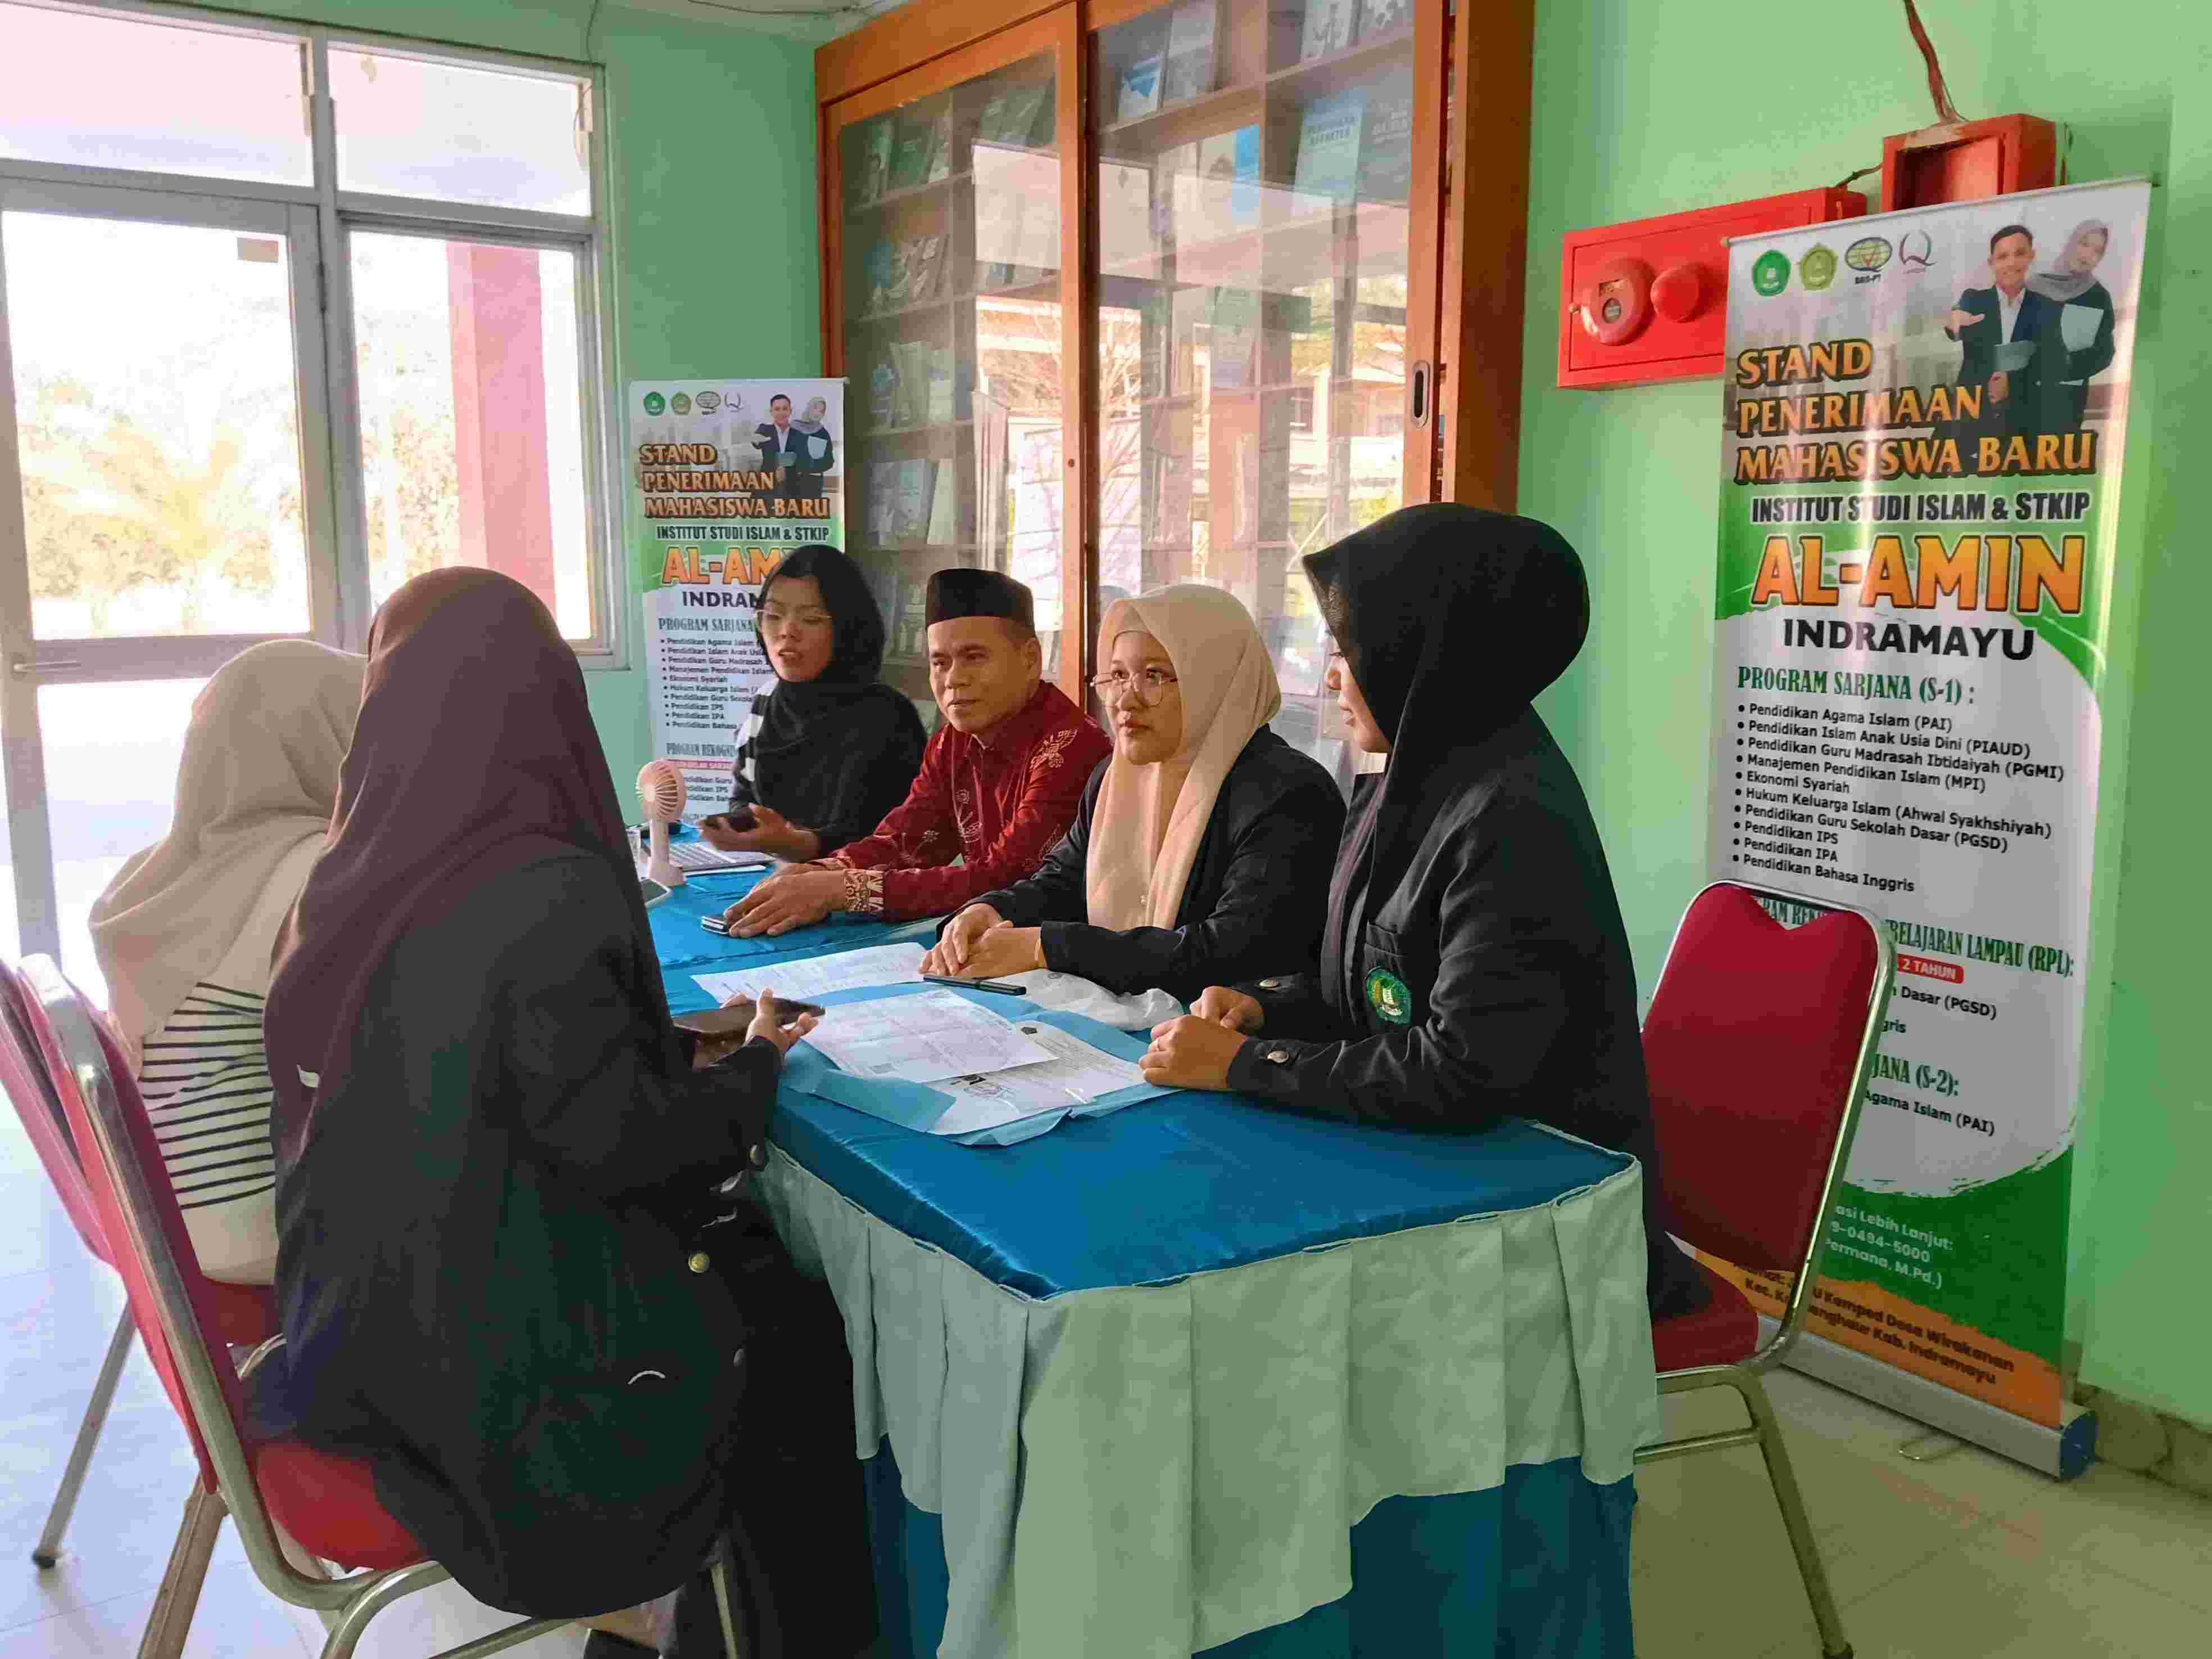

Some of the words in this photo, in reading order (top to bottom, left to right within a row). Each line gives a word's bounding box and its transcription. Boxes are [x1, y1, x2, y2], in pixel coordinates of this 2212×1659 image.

[1737, 339, 1872, 388] STAND
[1736, 386, 1983, 436] PENERIMAAN
[639, 444, 717, 465] STAND
[1735, 438, 1965, 484] MAHASISWA
[1977, 430, 2097, 475] BARU
[643, 472, 774, 492] PENERIMAAN
[645, 497, 768, 519] MAHASISWA
[774, 498, 831, 519] BARU
[1752, 496, 1843, 523] INSTITUT
[1916, 493, 1986, 520] ISLAM
[1992, 497, 2010, 519] &
[2015, 492, 2091, 520] STKIP
[656, 526, 706, 540] INSTITUT
[711, 526, 743, 540] STUDI
[746, 527, 780, 540] ISLAM
[783, 528, 793, 540] &
[795, 527, 829, 541] STKIP
[1750, 534, 2086, 614] AL-AMIN
[658, 618, 709, 631] PROGRAM
[1783, 618, 2034, 661] INDRAMAYU
[1737, 665, 1827, 693] PROGRAM
[1834, 672, 1911, 700] SARJANA
[1919, 677, 1962, 705] (S-1)
[1749, 703, 1818, 720] Pendidikan
[1823, 709, 1865, 724] Agama
[1869, 713, 1910, 727] Islam
[1915, 715, 1952, 733] (PAI)
[1749, 720, 1817, 737] Pendidikan
[1822, 726, 1856, 741] Islam
[1860, 730, 1895, 745] Anak
[1901, 733, 1930, 747] Usia
[1935, 736, 1962, 750] Dini
[1966, 739, 2030, 760] (PIAUD)
[1747, 754, 1820, 772] Manajemen
[1824, 761, 1896, 781] Pendidikan
[1901, 769, 1940, 786] Islam
[1946, 774, 1986, 794] (MPI)
[1748, 737, 1816, 754] Pendidikan
[1821, 744, 1851, 758] Guru
[1855, 748, 1923, 765] Madrasah
[2005, 761, 2064, 782] (PGMI)
[1747, 770, 1799, 787] Ekonomi
[1803, 777, 1850, 793] Syariah
[1746, 787, 1788, 803] Hukum
[1792, 793, 1848, 813] Keluarga
[1852, 800, 1891, 817] Islam
[1896, 805, 1945, 823] (Ahwal
[1949, 812, 2051, 840] Syakhshiyah)
[1746, 804, 1814, 823] Pendidikan
[1817, 814, 1847, 828] Guru
[1851, 818, 1906, 836] Sekolah
[1910, 826, 1950, 842] Dasar
[1955, 831, 2008, 854] (PGSD)
[1744, 837, 1812, 858] Pendidikan
[1815, 847, 1838, 862] IPA
[1745, 821, 1812, 841] Pendidikan
[1816, 831, 1839, 845] IPS
[1743, 854, 1811, 875] Pendidikan
[1815, 865, 1858, 884] Bahasa
[1863, 873, 1915, 892] Inggris
[1967, 933, 2025, 967] LAMPAU
[1903, 958, 1911, 971] 2
[1914, 960, 1956, 980] TAHUN
[1901, 986, 1941, 1005] Dasar
[1944, 995, 1997, 1021] (PGSD)
[1914, 1101, 1952, 1122] Islam
[1956, 1113, 1995, 1137] (PAI)
[1860, 1211, 1899, 1232] Lebih
[1902, 1224, 1953, 1250] Lanjut:
